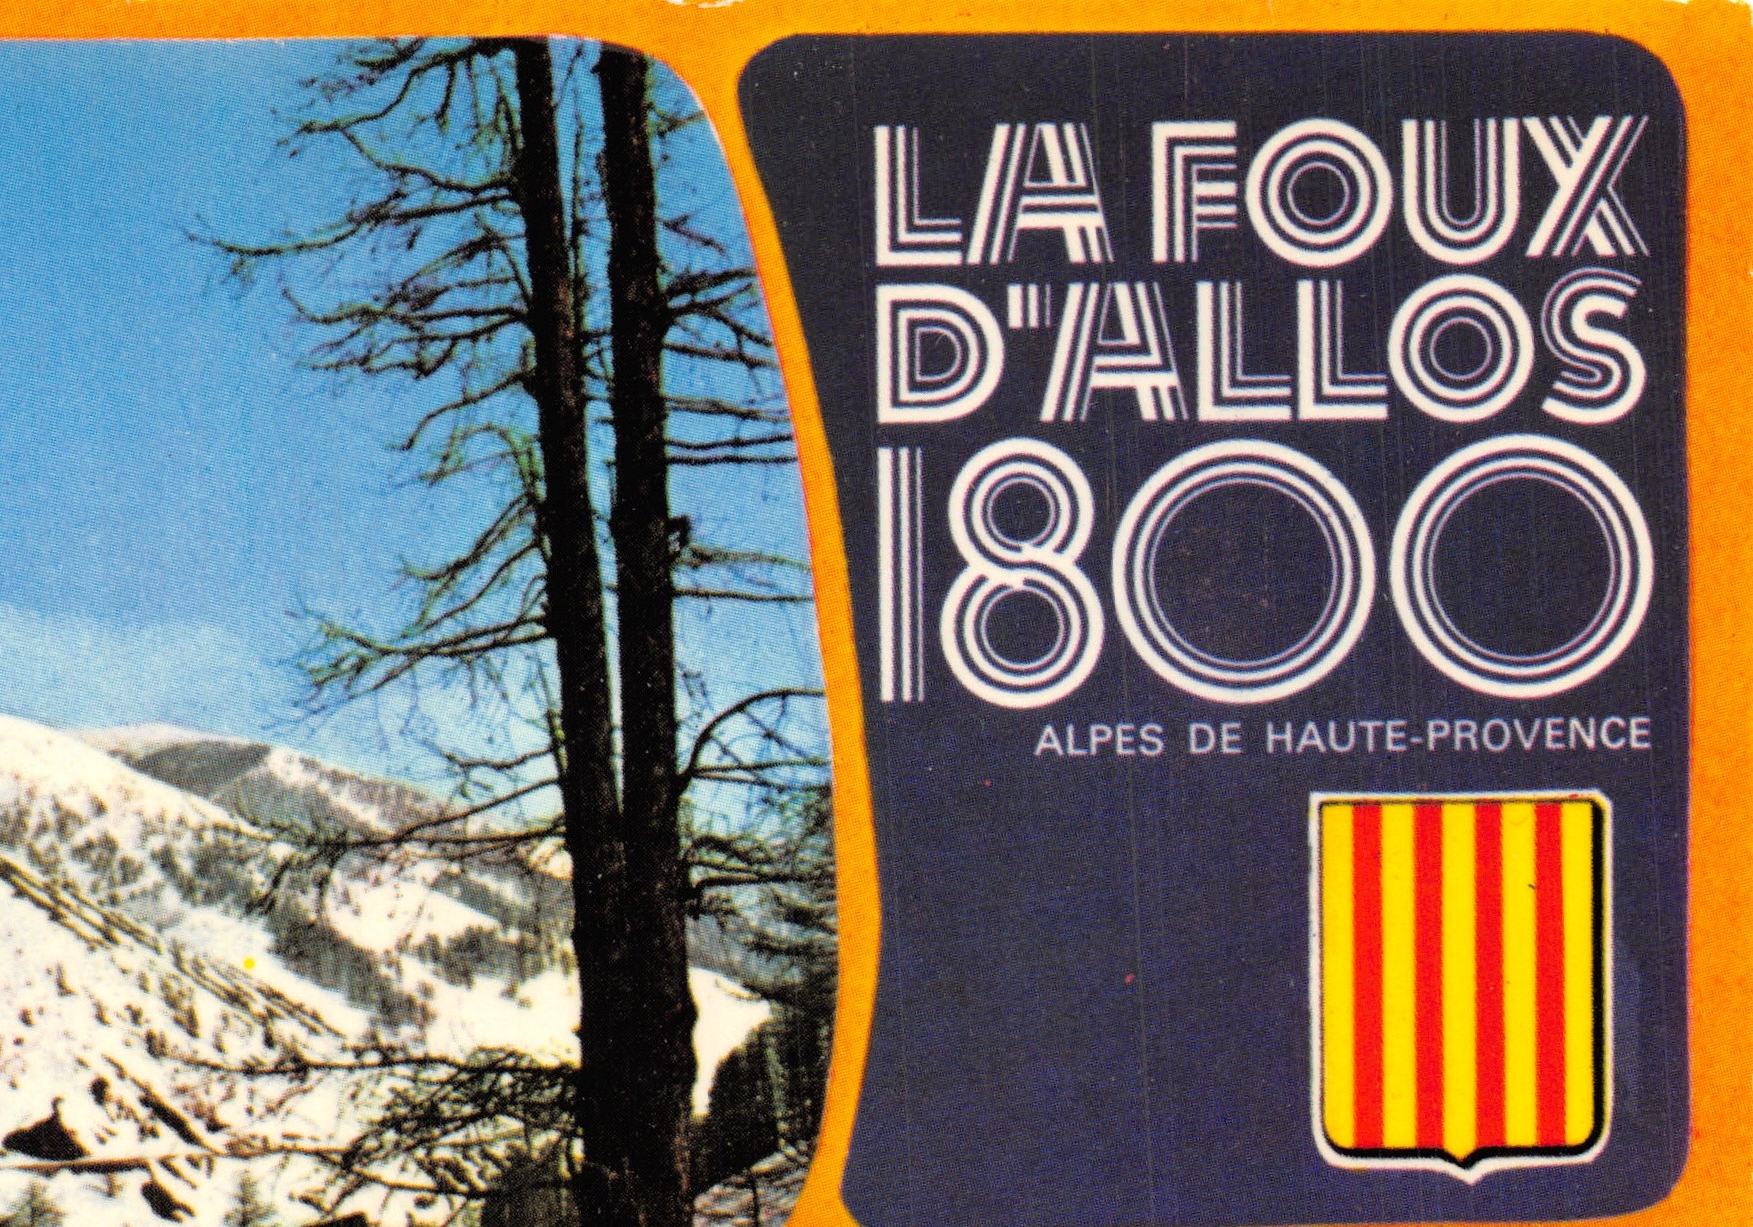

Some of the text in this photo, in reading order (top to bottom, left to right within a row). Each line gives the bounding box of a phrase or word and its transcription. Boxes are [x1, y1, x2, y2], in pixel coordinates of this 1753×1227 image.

[875, 115, 1648, 268] LA FOUX
[875, 267, 1647, 424] D'ALLOS
[877, 433, 1654, 709] 1800
[1034, 716, 1651, 757] ALPES DE HAUTE-PROVENCE
